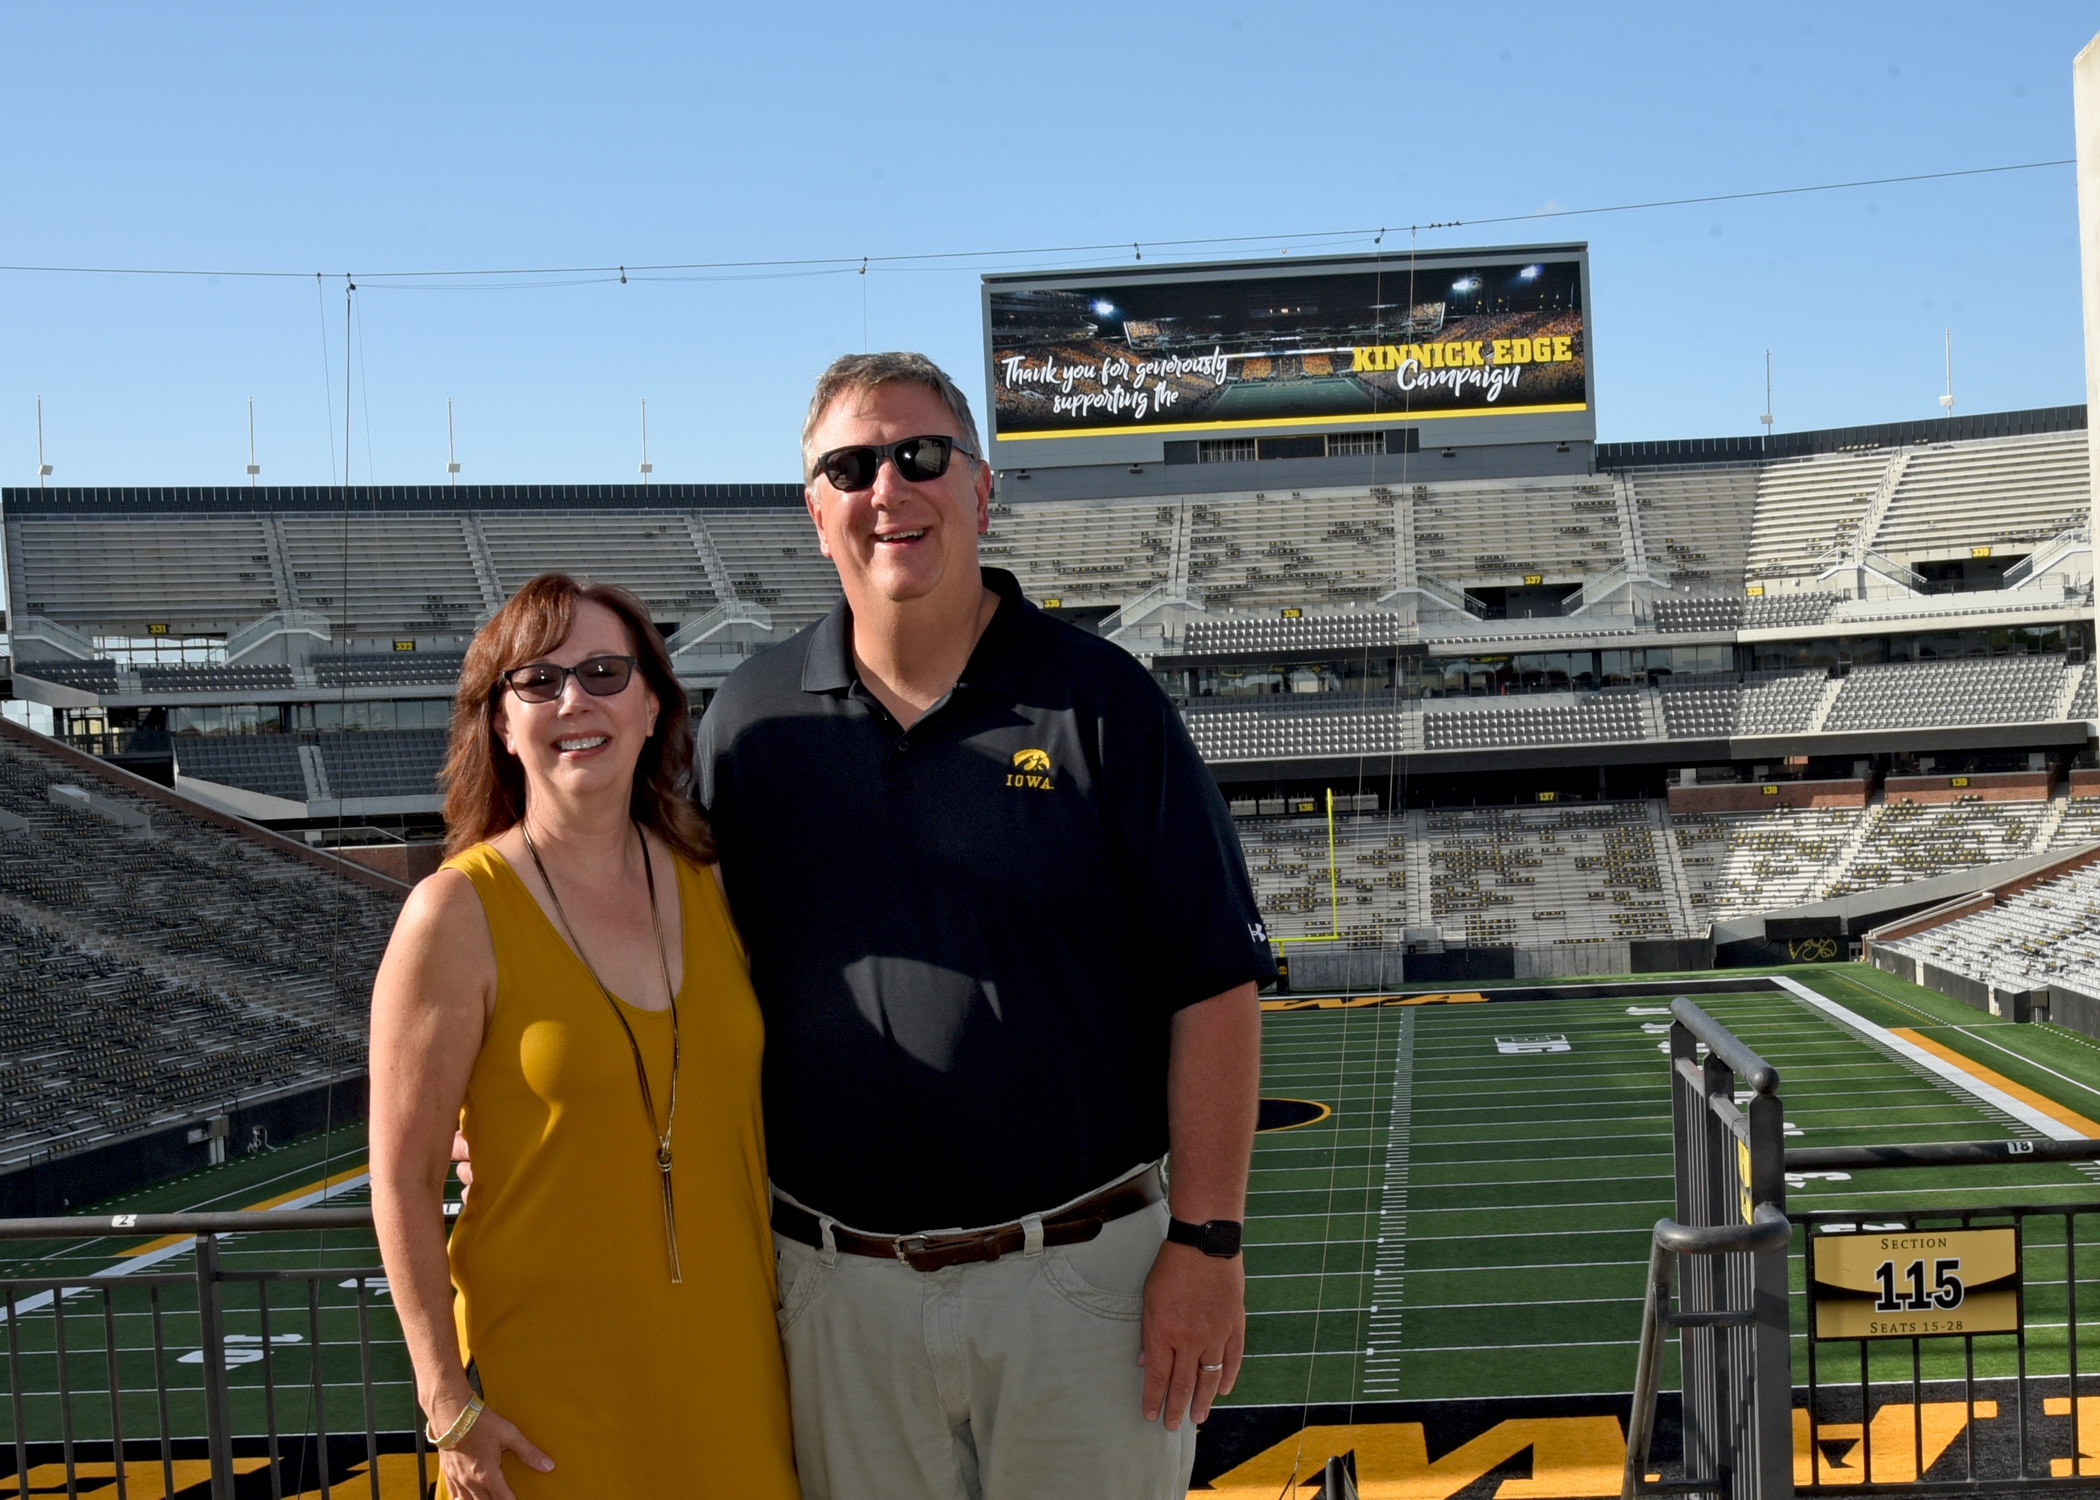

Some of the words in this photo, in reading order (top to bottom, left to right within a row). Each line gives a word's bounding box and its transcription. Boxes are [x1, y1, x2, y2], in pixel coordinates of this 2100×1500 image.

[1352, 340, 1485, 372] KINNICK
[1492, 336, 1573, 365] EDGE
[1001, 355, 1061, 389] Thank
[1062, 364, 1097, 393] you
[1101, 357, 1130, 385] for
[1136, 346, 1228, 389] generously
[1397, 358, 1521, 402] Campaign
[1053, 384, 1148, 419] supporting
[1154, 380, 1179, 412] the
[1972, 548, 1989, 557] 339
[1525, 576, 1541, 585] 337
[1044, 600, 1060, 608] 335
[150, 625, 167, 633] 331
[395, 642, 413, 650] 332
[1006, 774, 1055, 790] IOWA
[1952, 778, 1968, 786] 139
[1763, 786, 1778, 794] 138
[1540, 792, 1555, 801] 137
[2010, 1142, 2031, 1151] 18
[119, 1215, 129, 1225] 2
[1881, 1237, 1948, 1250] SECTION
[1874, 1257, 1965, 1313] 115
[1870, 1321, 1916, 1334] SEATS
[1923, 1320, 1964, 1332] 15-28
